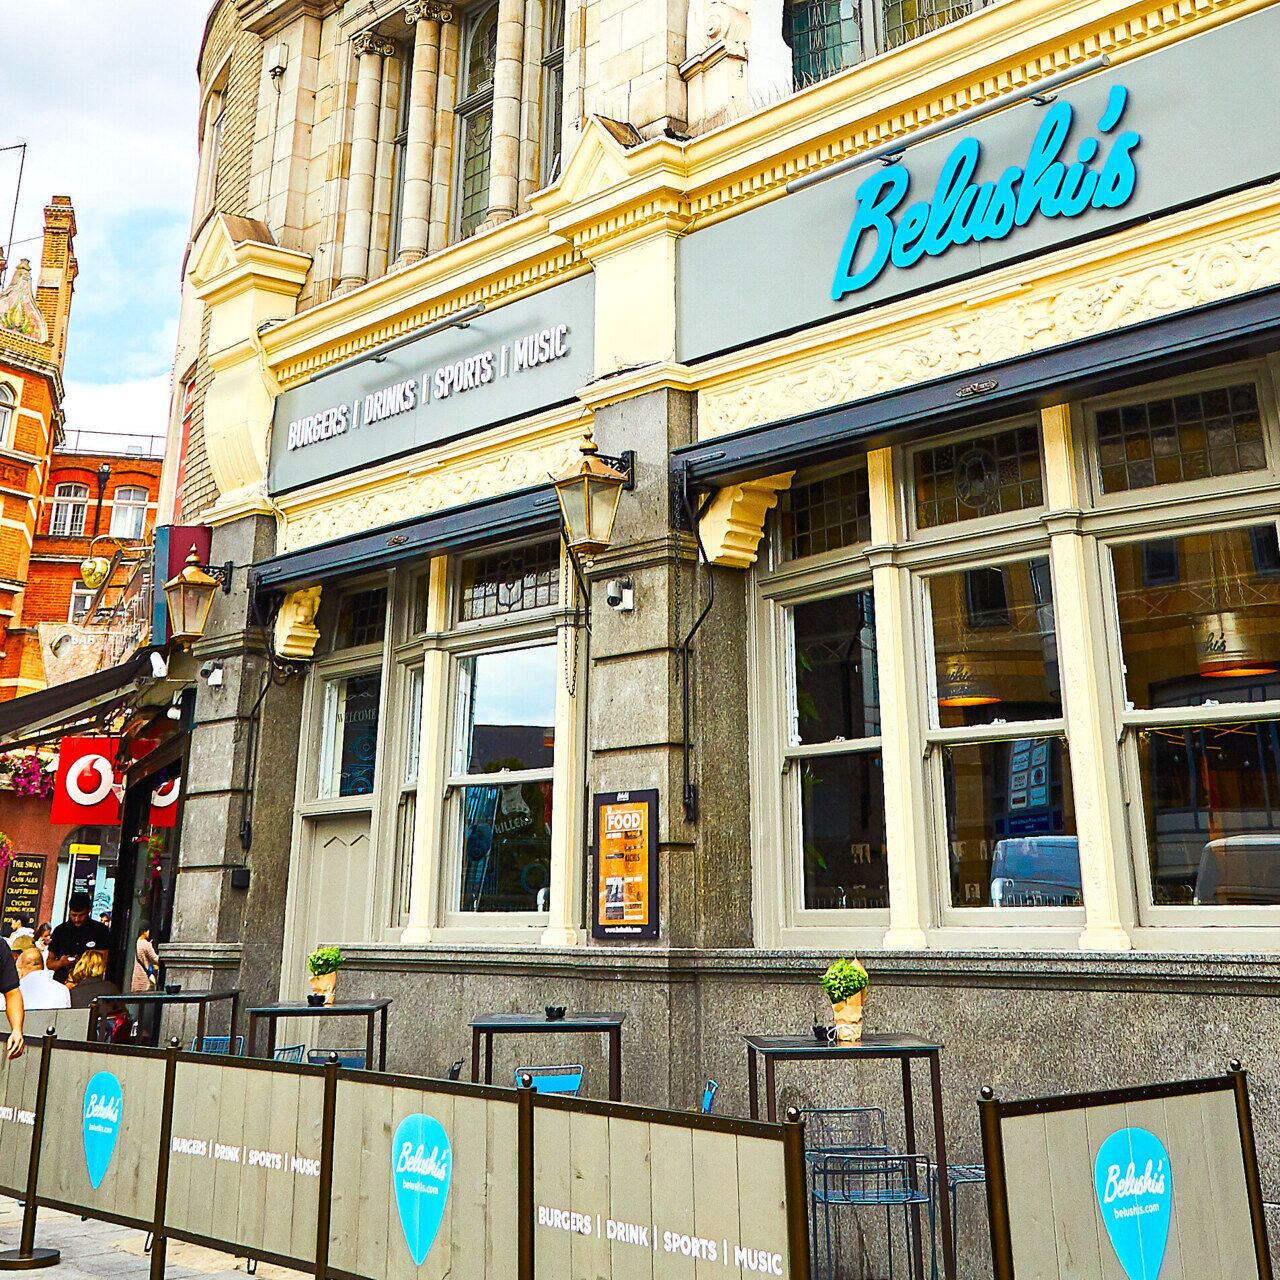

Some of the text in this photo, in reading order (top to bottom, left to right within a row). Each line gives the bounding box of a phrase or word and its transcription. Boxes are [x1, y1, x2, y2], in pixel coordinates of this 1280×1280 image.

[831, 84, 1142, 301] Belushi's
[287, 324, 570, 451] BURGERS DRINKS SPORTS MUSIC
[337, 707, 377, 723] WELCOME
[608, 813, 641, 831] FOOD
[13, 860, 42, 869] THE SWAN
[17, 1109, 36, 1126] MUSIC
[172, 1136, 320, 1177] BURGERS DRINK SPORTS MUSIC
[396, 1141, 450, 1182] Belushi's
[402, 1179, 439, 1195] belushis.com
[1103, 1158, 1166, 1204] Belushi's
[1114, 1203, 1160, 1219] belushis.com
[538, 1205, 783, 1276] BURGERS DRINK SPORTS MUSIC
